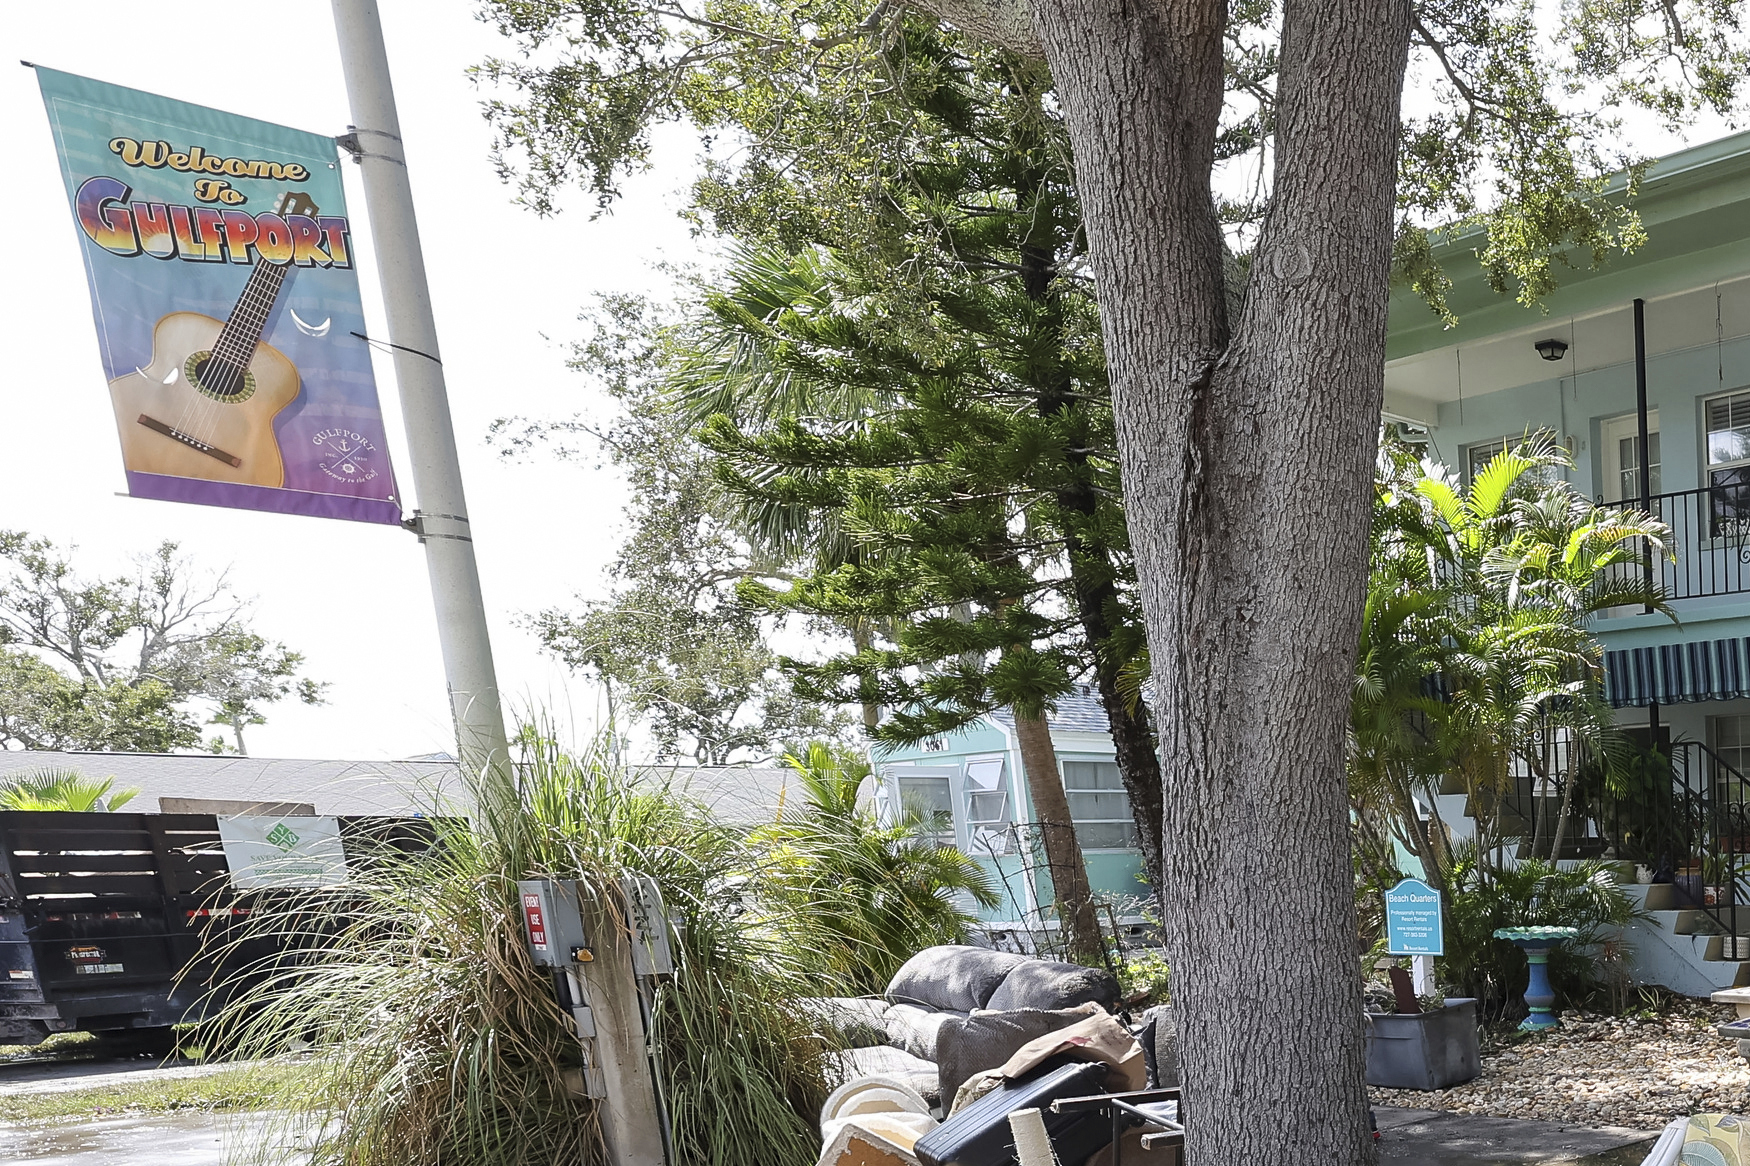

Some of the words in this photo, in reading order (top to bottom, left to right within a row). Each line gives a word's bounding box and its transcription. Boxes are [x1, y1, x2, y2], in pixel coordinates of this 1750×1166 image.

[109, 137, 309, 181] Welcome
[194, 179, 248, 205] To
[76, 176, 353, 268] GULFPORT
[312, 428, 376, 451] GULFPORT
[525, 896, 540, 908] EVENT
[1389, 894, 1408, 902] Beach
[1410, 894, 1437, 902] Quarters
[530, 914, 540, 925] USE
[532, 932, 545, 942] ONLY
